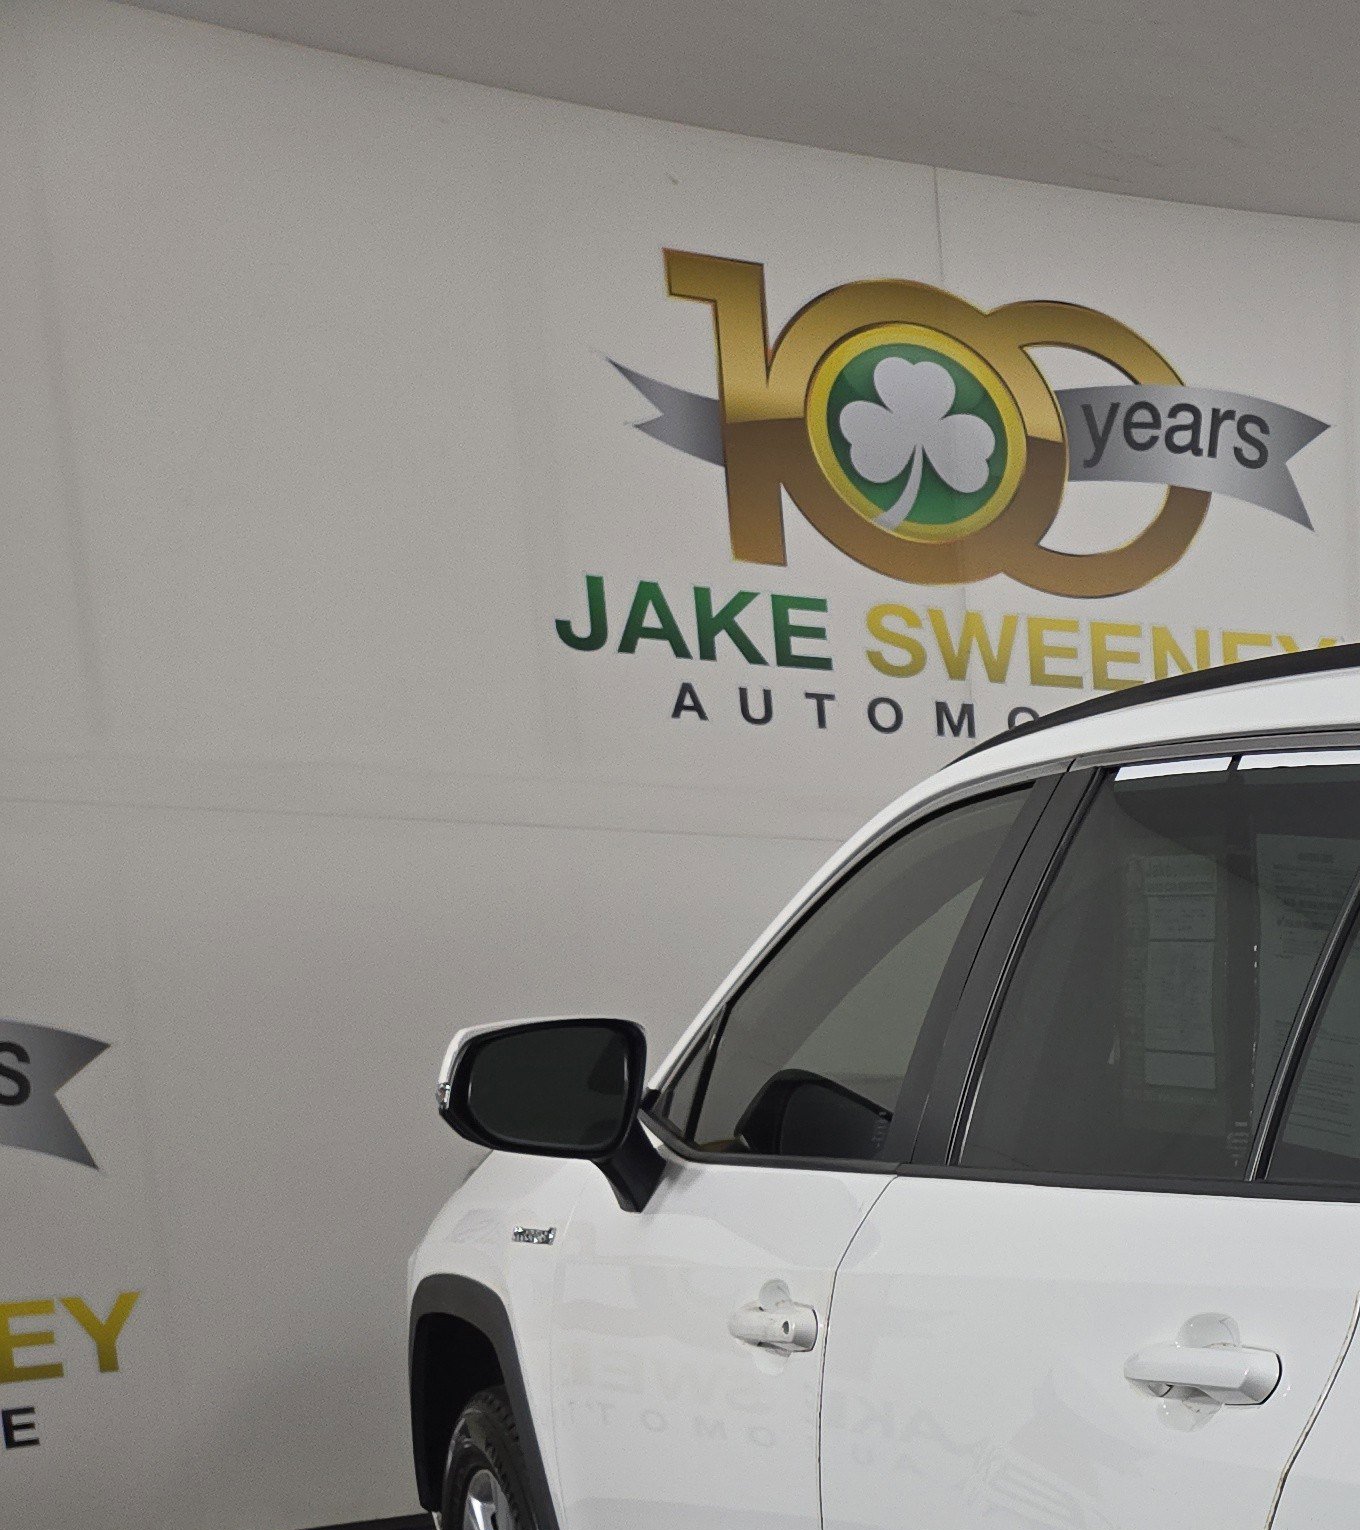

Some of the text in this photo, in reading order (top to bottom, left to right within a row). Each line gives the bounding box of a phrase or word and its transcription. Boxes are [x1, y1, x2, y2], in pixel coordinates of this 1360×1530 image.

[1082, 400, 1270, 470] years
[555, 574, 1338, 690] JAKE SWEEN
